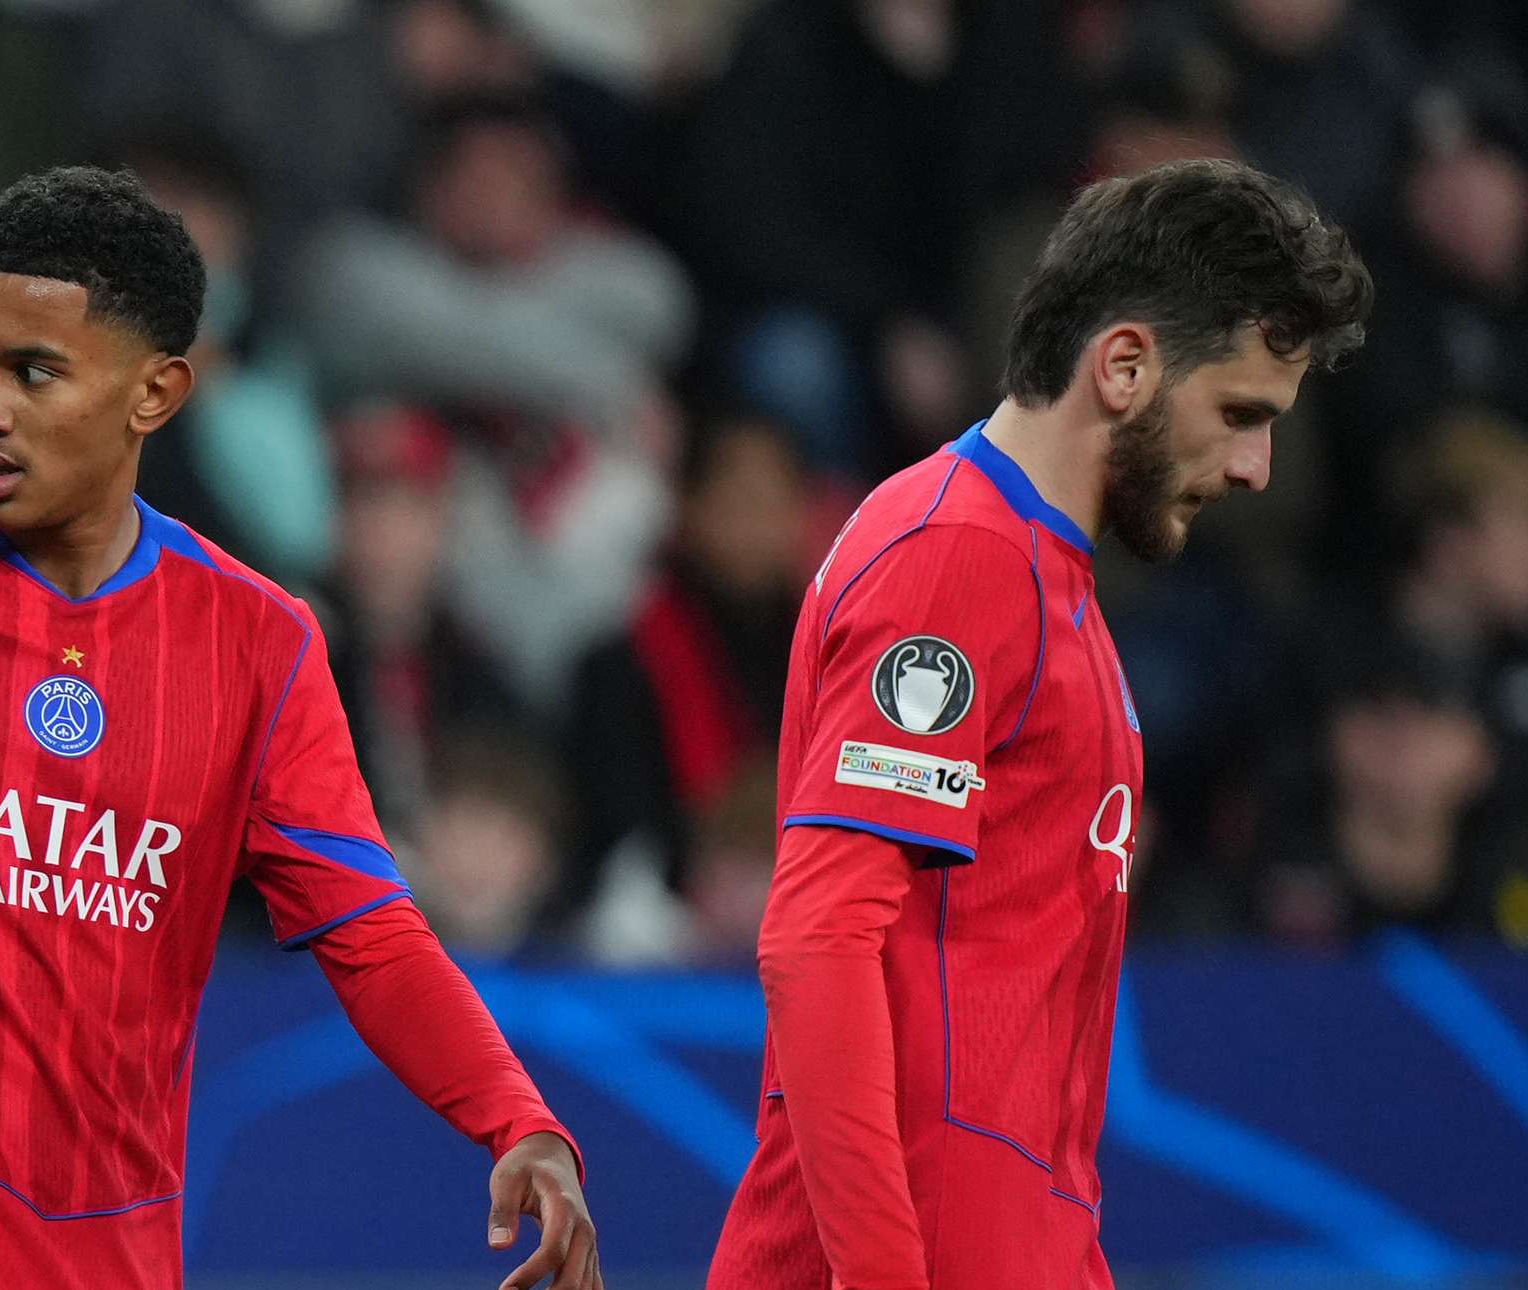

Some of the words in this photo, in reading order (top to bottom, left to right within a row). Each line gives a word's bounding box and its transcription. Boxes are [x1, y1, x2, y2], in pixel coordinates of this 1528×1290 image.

[40, 682, 92, 705] PARIS
[842, 756, 933, 782] FOUNDATION
[935, 767, 966, 793] 10
